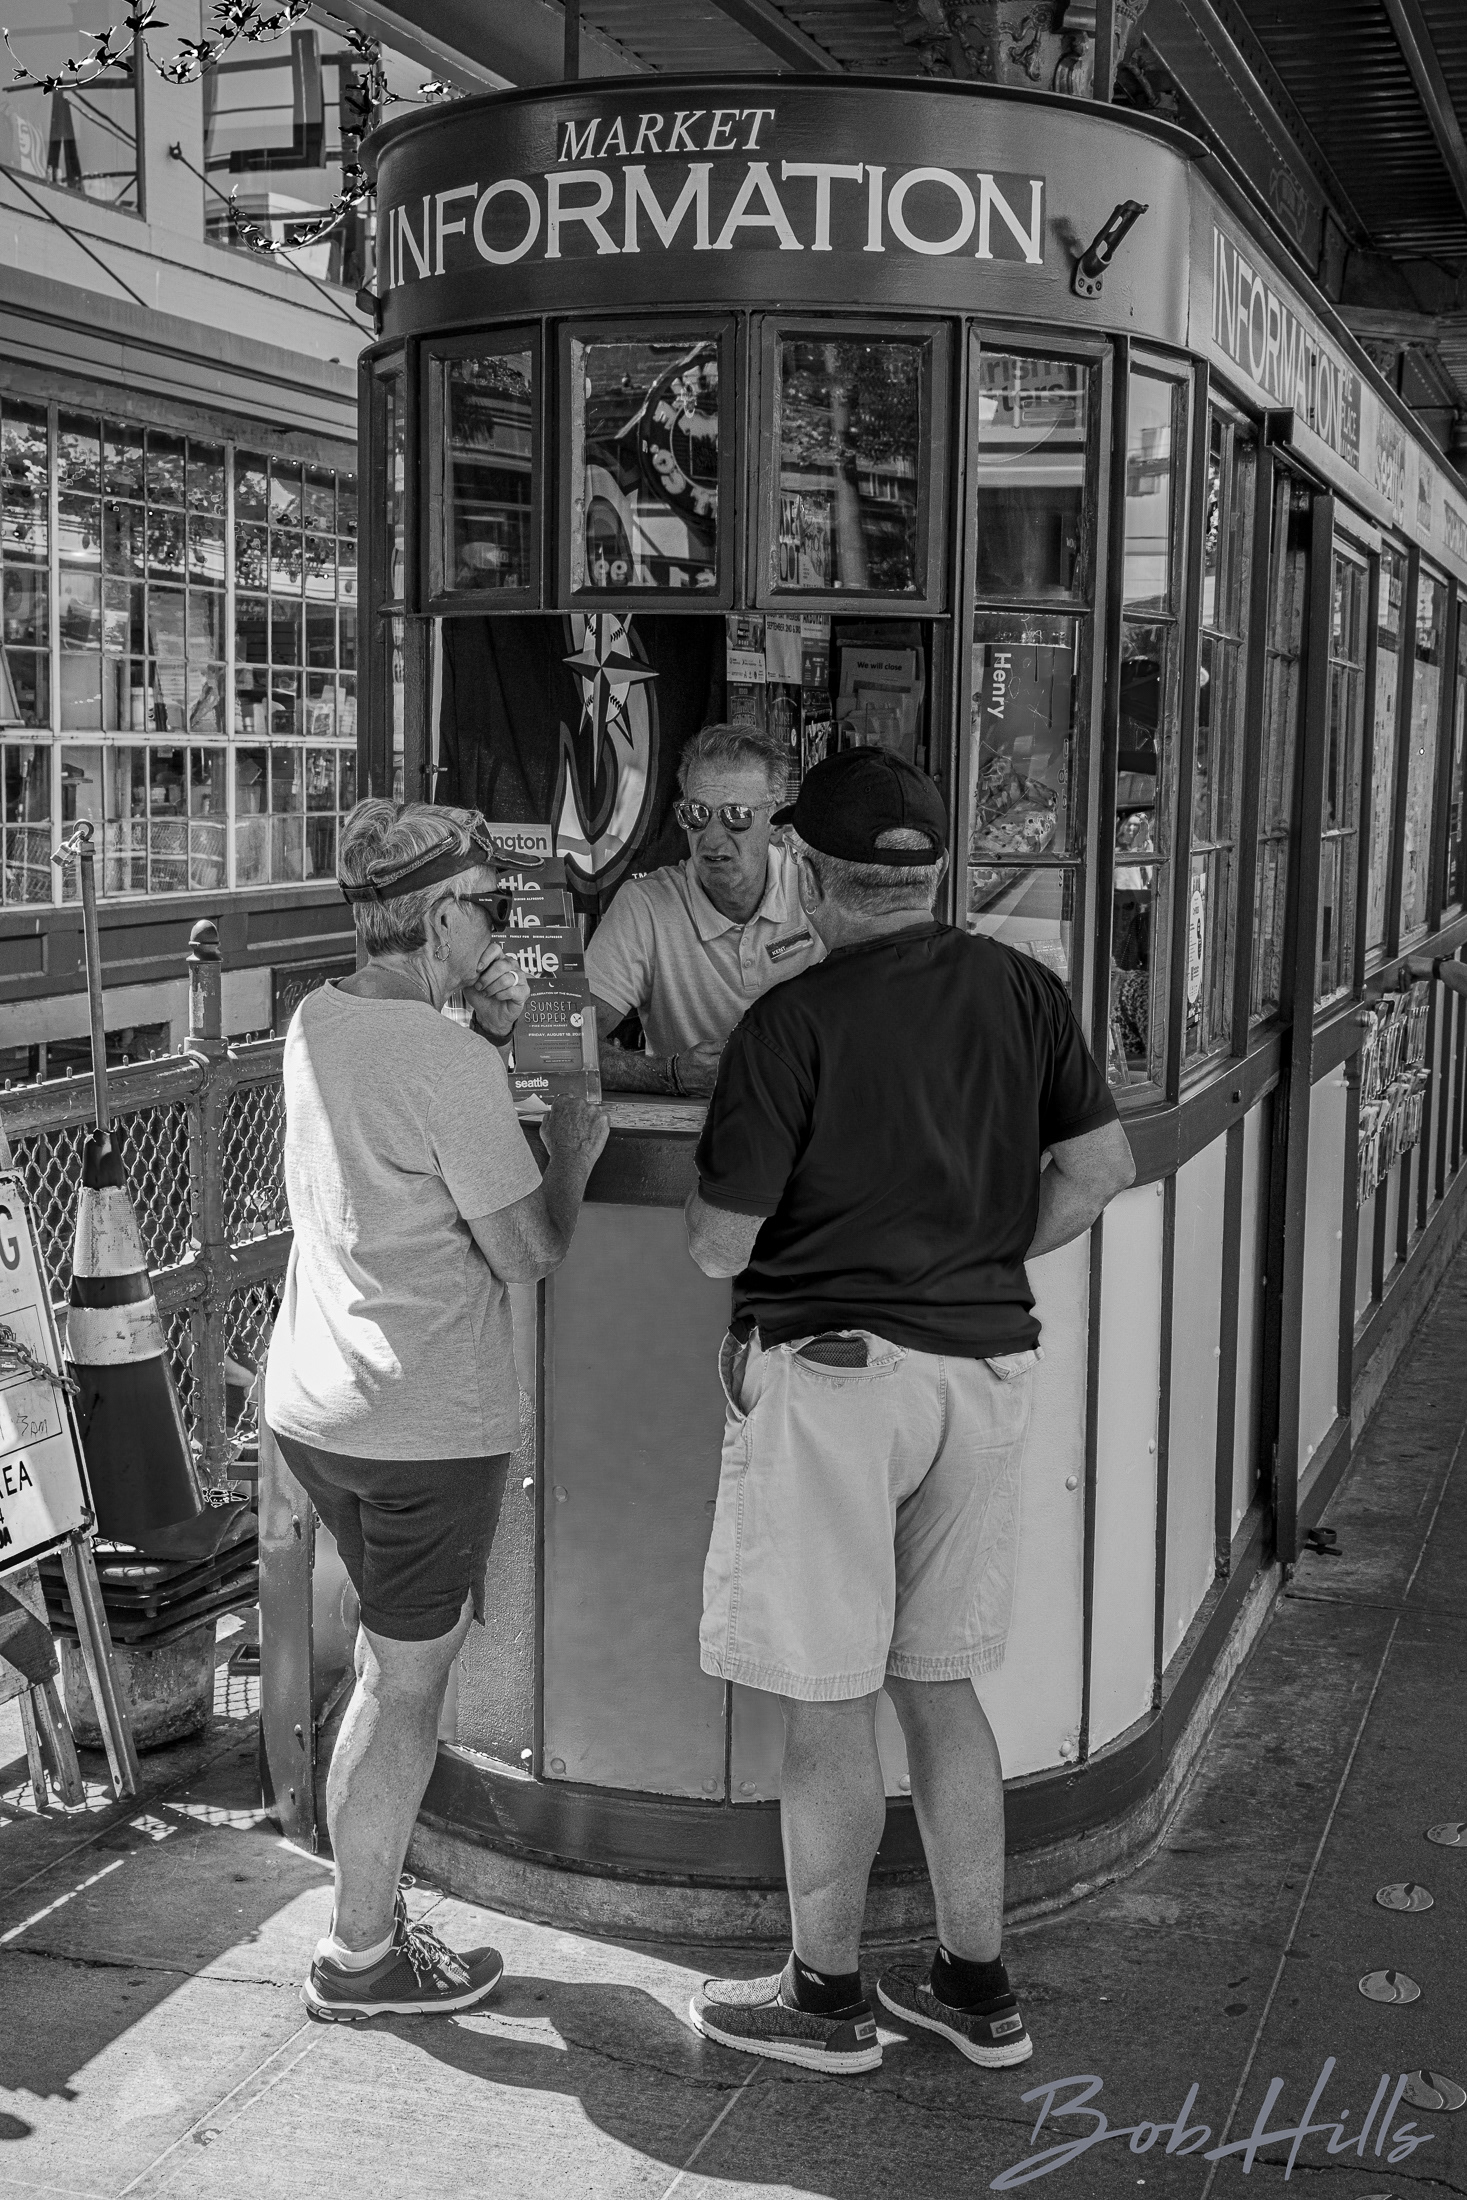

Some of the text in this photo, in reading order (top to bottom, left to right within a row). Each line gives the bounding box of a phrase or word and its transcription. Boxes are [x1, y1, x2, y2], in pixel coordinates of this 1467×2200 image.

[557, 108, 776, 162] MARKET
[388, 160, 1045, 289] INFORMATION
[1212, 225, 1343, 456] INFORMATION
[857, 661, 903, 671] We will close
[987, 652, 1012, 719] Henry
[771, 945, 787, 956] KENT
[524, 1011, 567, 1023] SUPPER
[530, 1000, 572, 1012] SUNSET
[514, 1076, 550, 1089] seattle
[0, 1460, 33, 1499] EA
